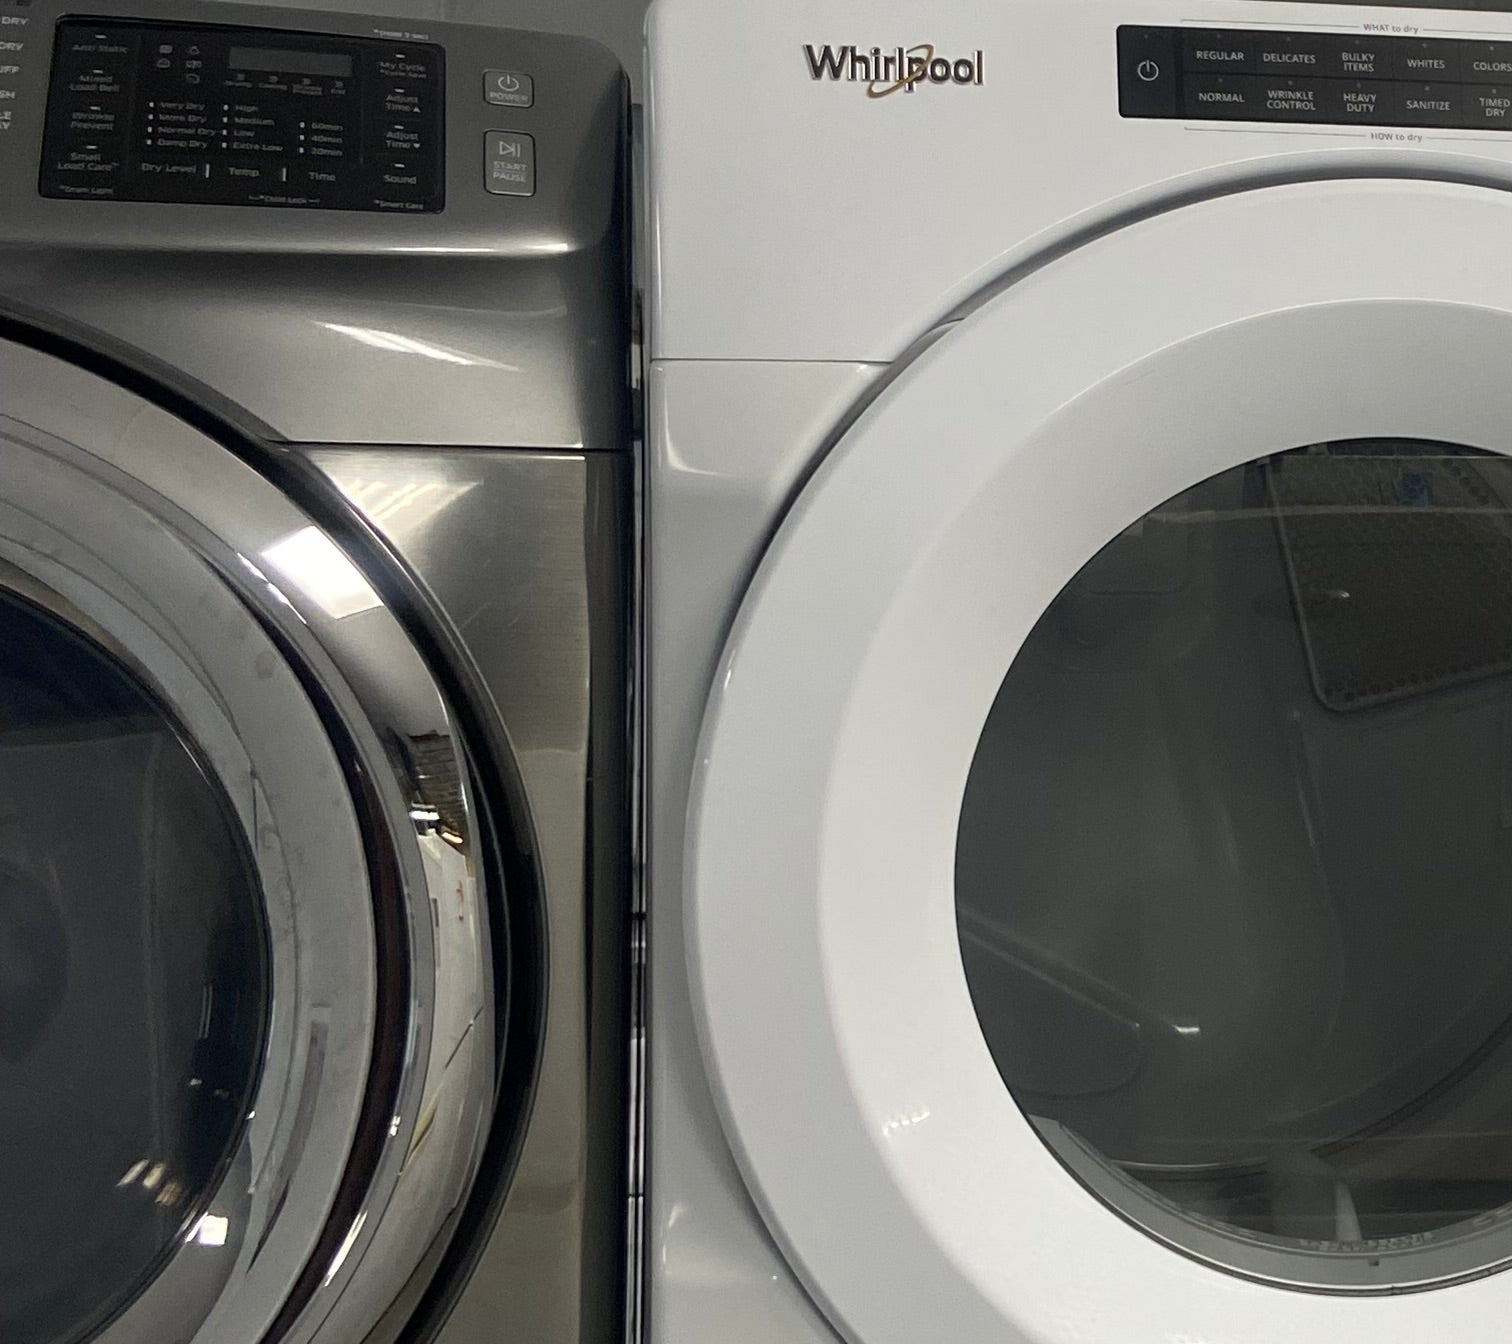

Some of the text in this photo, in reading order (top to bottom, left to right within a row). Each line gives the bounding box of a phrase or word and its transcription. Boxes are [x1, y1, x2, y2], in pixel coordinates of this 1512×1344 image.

[1362, 22, 1419, 36] WHAT to dry
[1196, 50, 1244, 61] REGULAR
[1262, 52, 1317, 64] DELICATES
[1342, 52, 1375, 63] BULKY
[802, 43, 985, 94] Whirlpool
[1343, 62, 1375, 73] ITEMS
[1407, 59, 1446, 69] WHITES
[1473, 61, 1512, 72] COLORS
[489, 90, 529, 102] POWER
[1198, 92, 1245, 103] NORMAL
[1267, 90, 1314, 101] WRINKLE
[1343, 93, 1376, 104] HEAVY
[1266, 100, 1317, 111] CONTROL
[1346, 103, 1375, 113] DUTY
[1405, 100, 1451, 111] SANITIZE
[1479, 97, 1511, 108] TIMED
[1485, 107, 1505, 117] DRY
[1396, 133, 1404, 141] to
[1406, 133, 1423, 143] dry
[141, 162, 197, 174] Dry Level
[491, 159, 528, 171] START
[308, 170, 336, 182] Time
[382, 174, 418, 185] Sound
[491, 171, 527, 183] PAUSE
